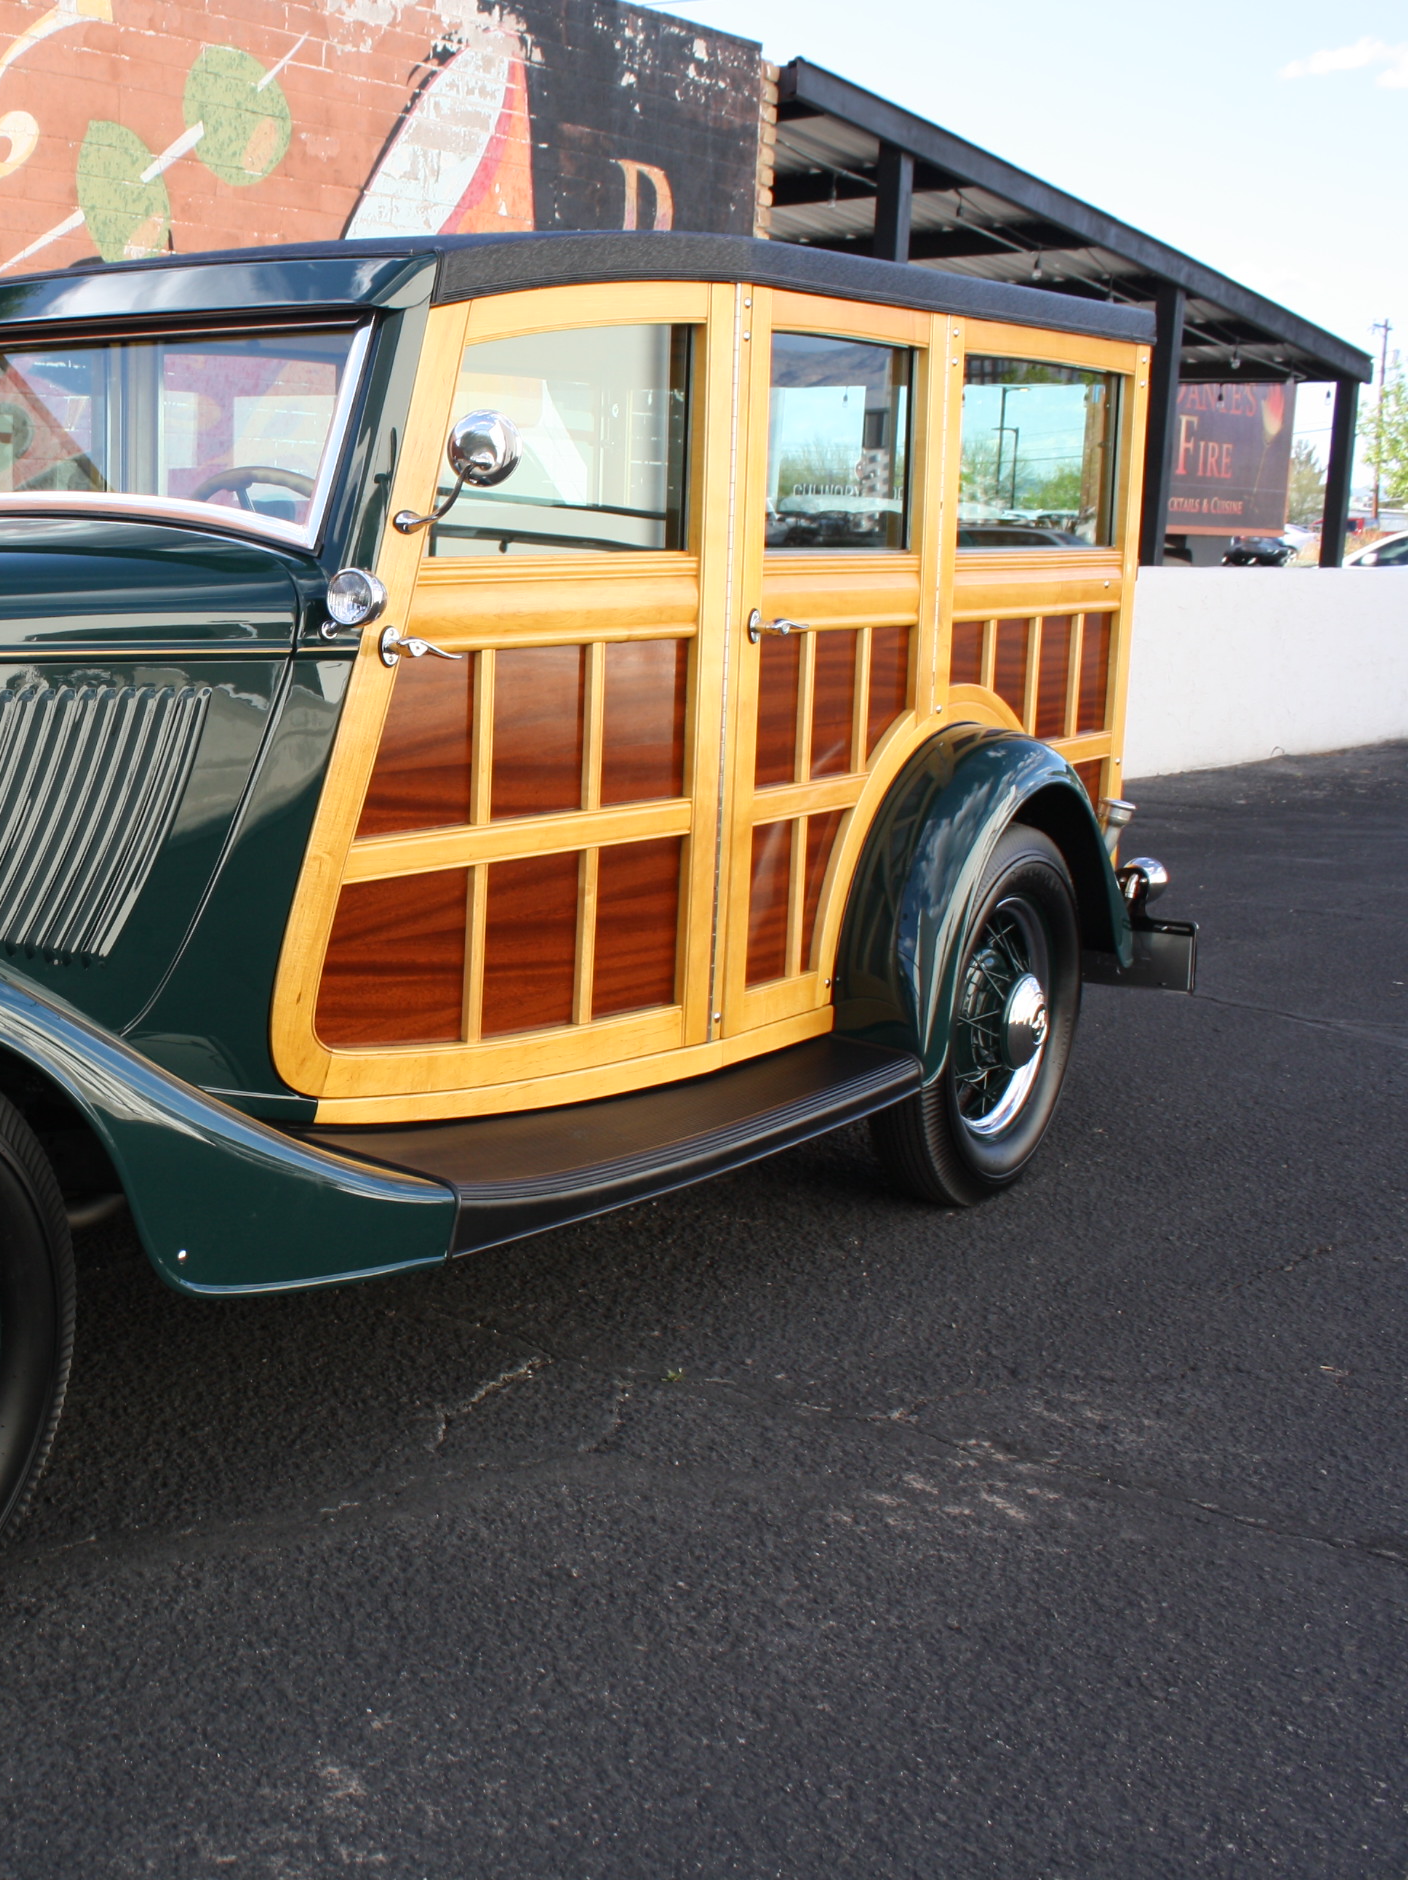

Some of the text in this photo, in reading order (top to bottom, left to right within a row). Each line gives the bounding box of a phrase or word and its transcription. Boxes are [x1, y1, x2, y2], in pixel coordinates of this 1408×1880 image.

[1175, 414, 1233, 479] FIRE
[1202, 498, 1209, 513] &
[1211, 497, 1244, 515] CUISINE
